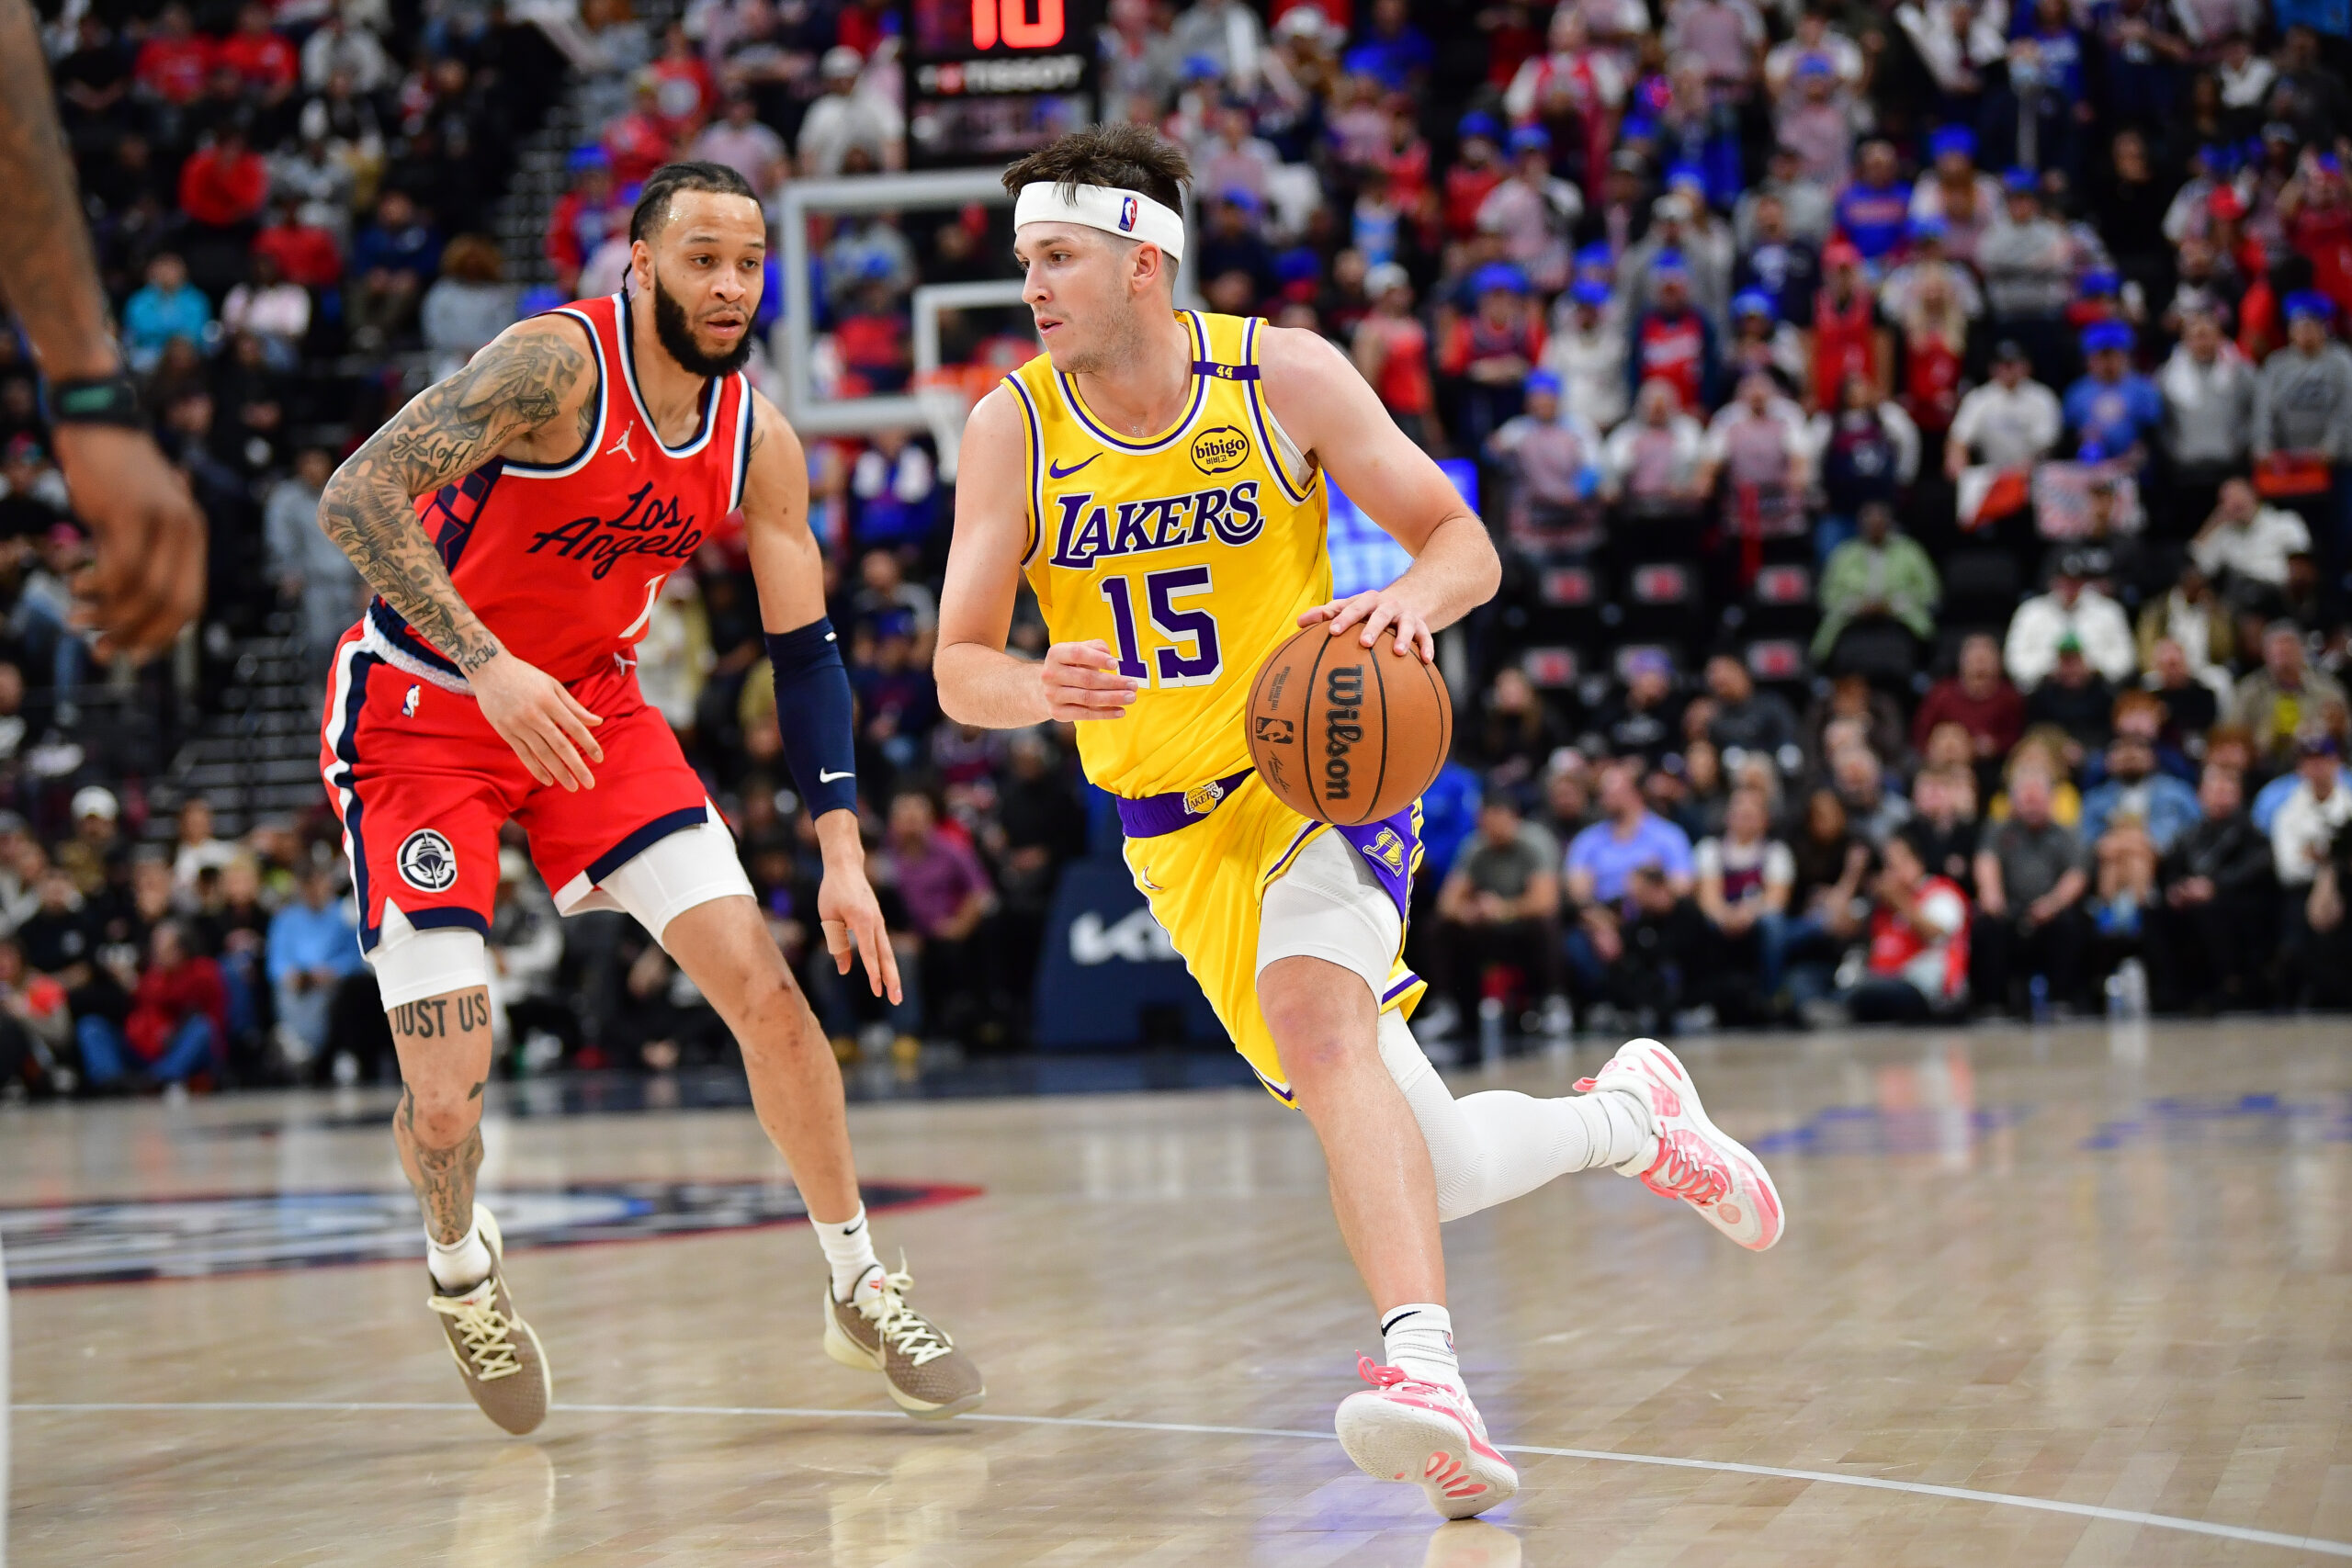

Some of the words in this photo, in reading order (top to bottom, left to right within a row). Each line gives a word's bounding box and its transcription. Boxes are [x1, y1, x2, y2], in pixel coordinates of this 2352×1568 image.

[1216, 365, 1234, 378] 44
[1195, 438, 1246, 459] bibigo
[1205, 454, 1227, 466] 비비고
[605, 480, 682, 532] Los
[1049, 480, 1267, 570] LAKERS
[526, 514, 702, 581] Angele
[1098, 564, 1224, 689] 15
[1325, 663, 1364, 801] Wilson
[395, 998, 447, 1038] JUST
[458, 992, 488, 1032] US
